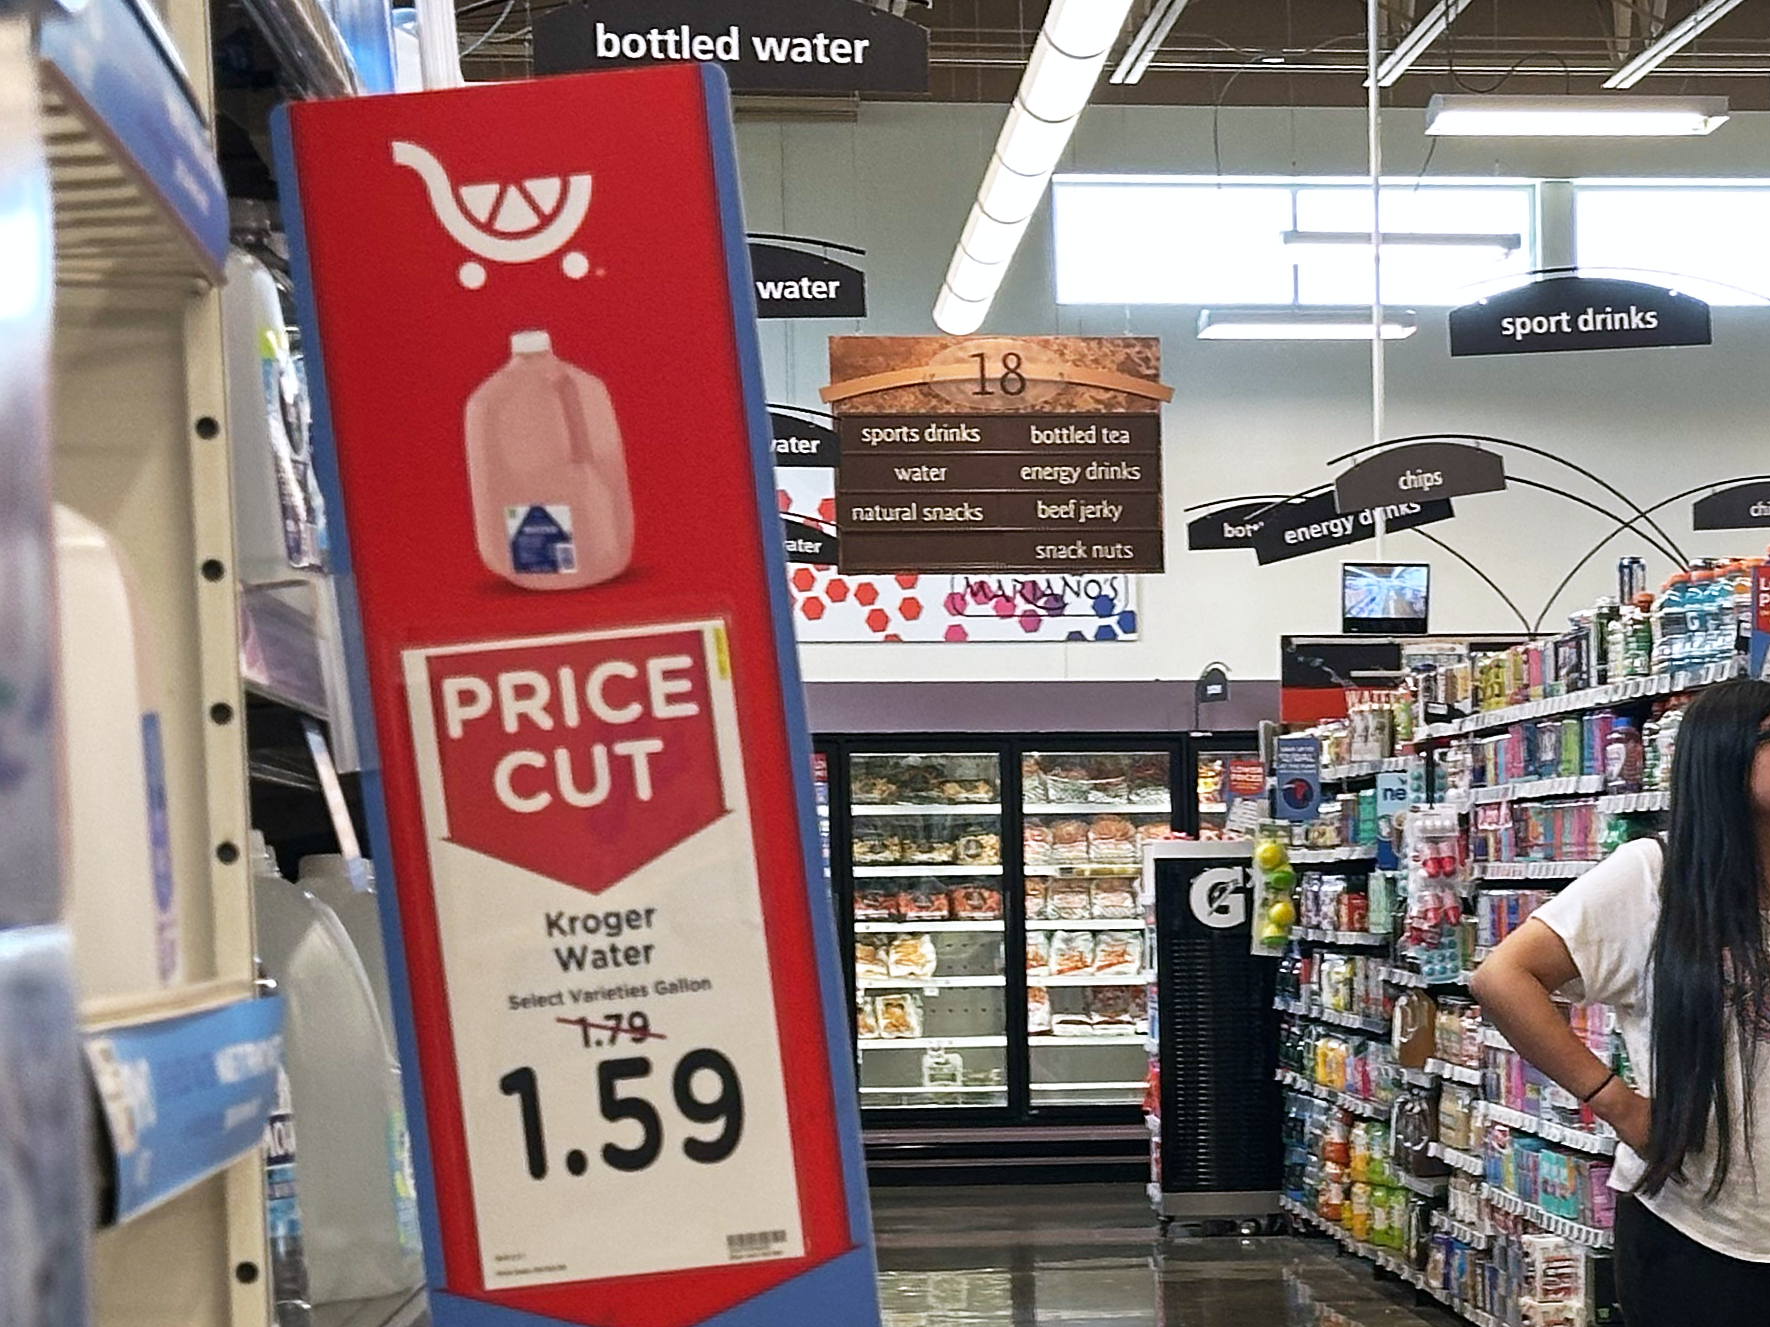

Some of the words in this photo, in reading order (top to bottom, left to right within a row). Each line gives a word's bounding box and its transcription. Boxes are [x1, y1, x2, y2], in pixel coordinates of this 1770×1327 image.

[597, 24, 739, 61] bottled
[752, 34, 869, 64] water
[756, 276, 840, 299] water
[1501, 306, 1571, 340] sport
[1577, 304, 1659, 333] drinks
[969, 352, 1026, 395] 18
[861, 425, 919, 445] sports
[925, 423, 981, 442] drinks
[1030, 425, 1096, 444] bottled
[1102, 428, 1130, 444] tea
[894, 466, 948, 482] water
[1020, 465, 1081, 484] energy
[1086, 462, 1141, 480] drinks
[1399, 469, 1443, 491] chips
[852, 503, 917, 521] natural
[923, 503, 983, 522] snacks
[1037, 500, 1077, 519] beef
[1078, 501, 1122, 523] jerky
[1284, 515, 1354, 544] energy
[784, 539, 822, 553] ater
[1035, 541, 1088, 559] snack
[1092, 542, 1134, 559] nuts
[439, 653, 700, 739] PRICE
[493, 739, 665, 814] CUT
[545, 907, 657, 938] Kroger
[554, 943, 655, 973] Water
[508, 991, 565, 1011] Select
[568, 983, 649, 1005] Varieties
[654, 976, 713, 996] Gallon
[578, 1011, 652, 1048] 1.79
[500, 1047, 744, 1181] 1.59
